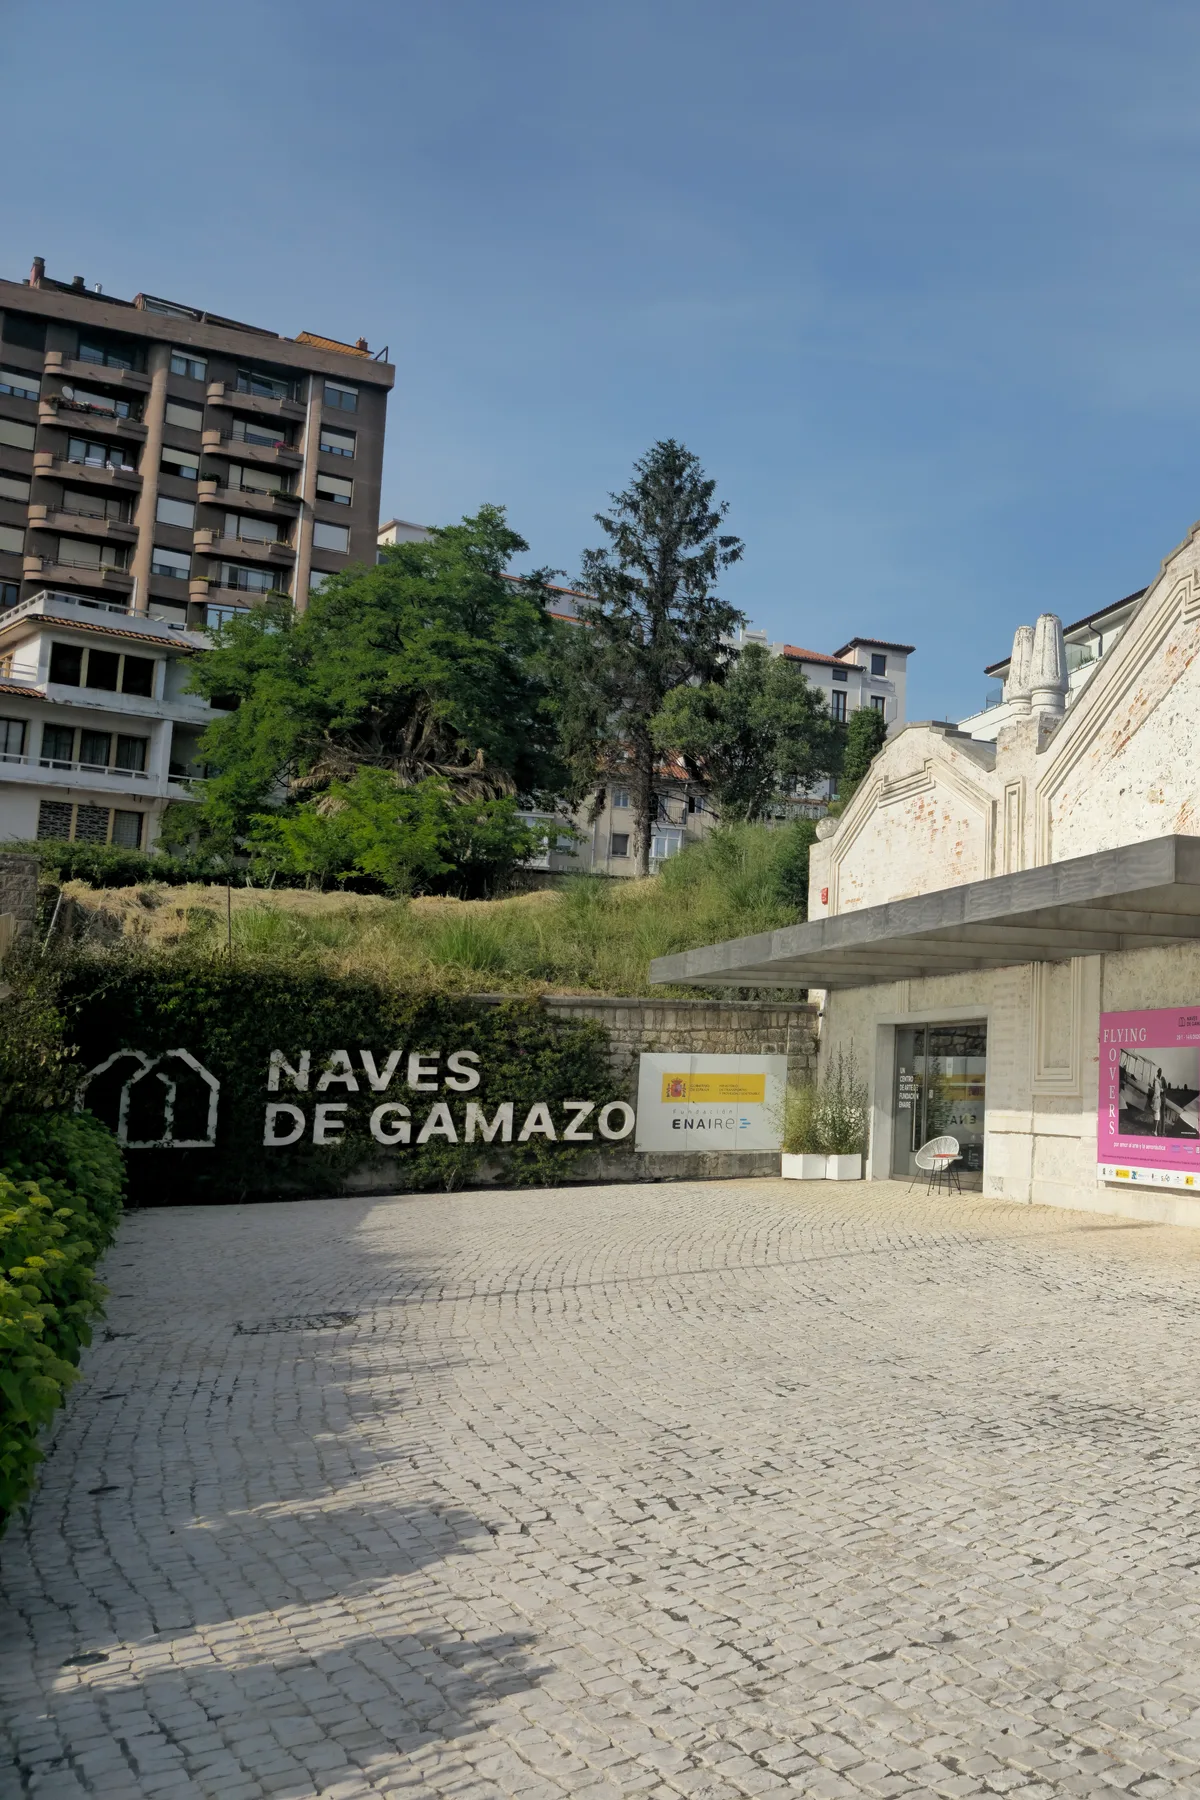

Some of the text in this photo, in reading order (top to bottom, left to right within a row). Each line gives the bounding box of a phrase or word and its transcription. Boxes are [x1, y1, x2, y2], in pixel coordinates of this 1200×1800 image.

[1104, 1028, 1146, 1043] FLYING
[266, 1048, 481, 1092] NAVES
[262, 1100, 636, 1148] DE GAMAZO
